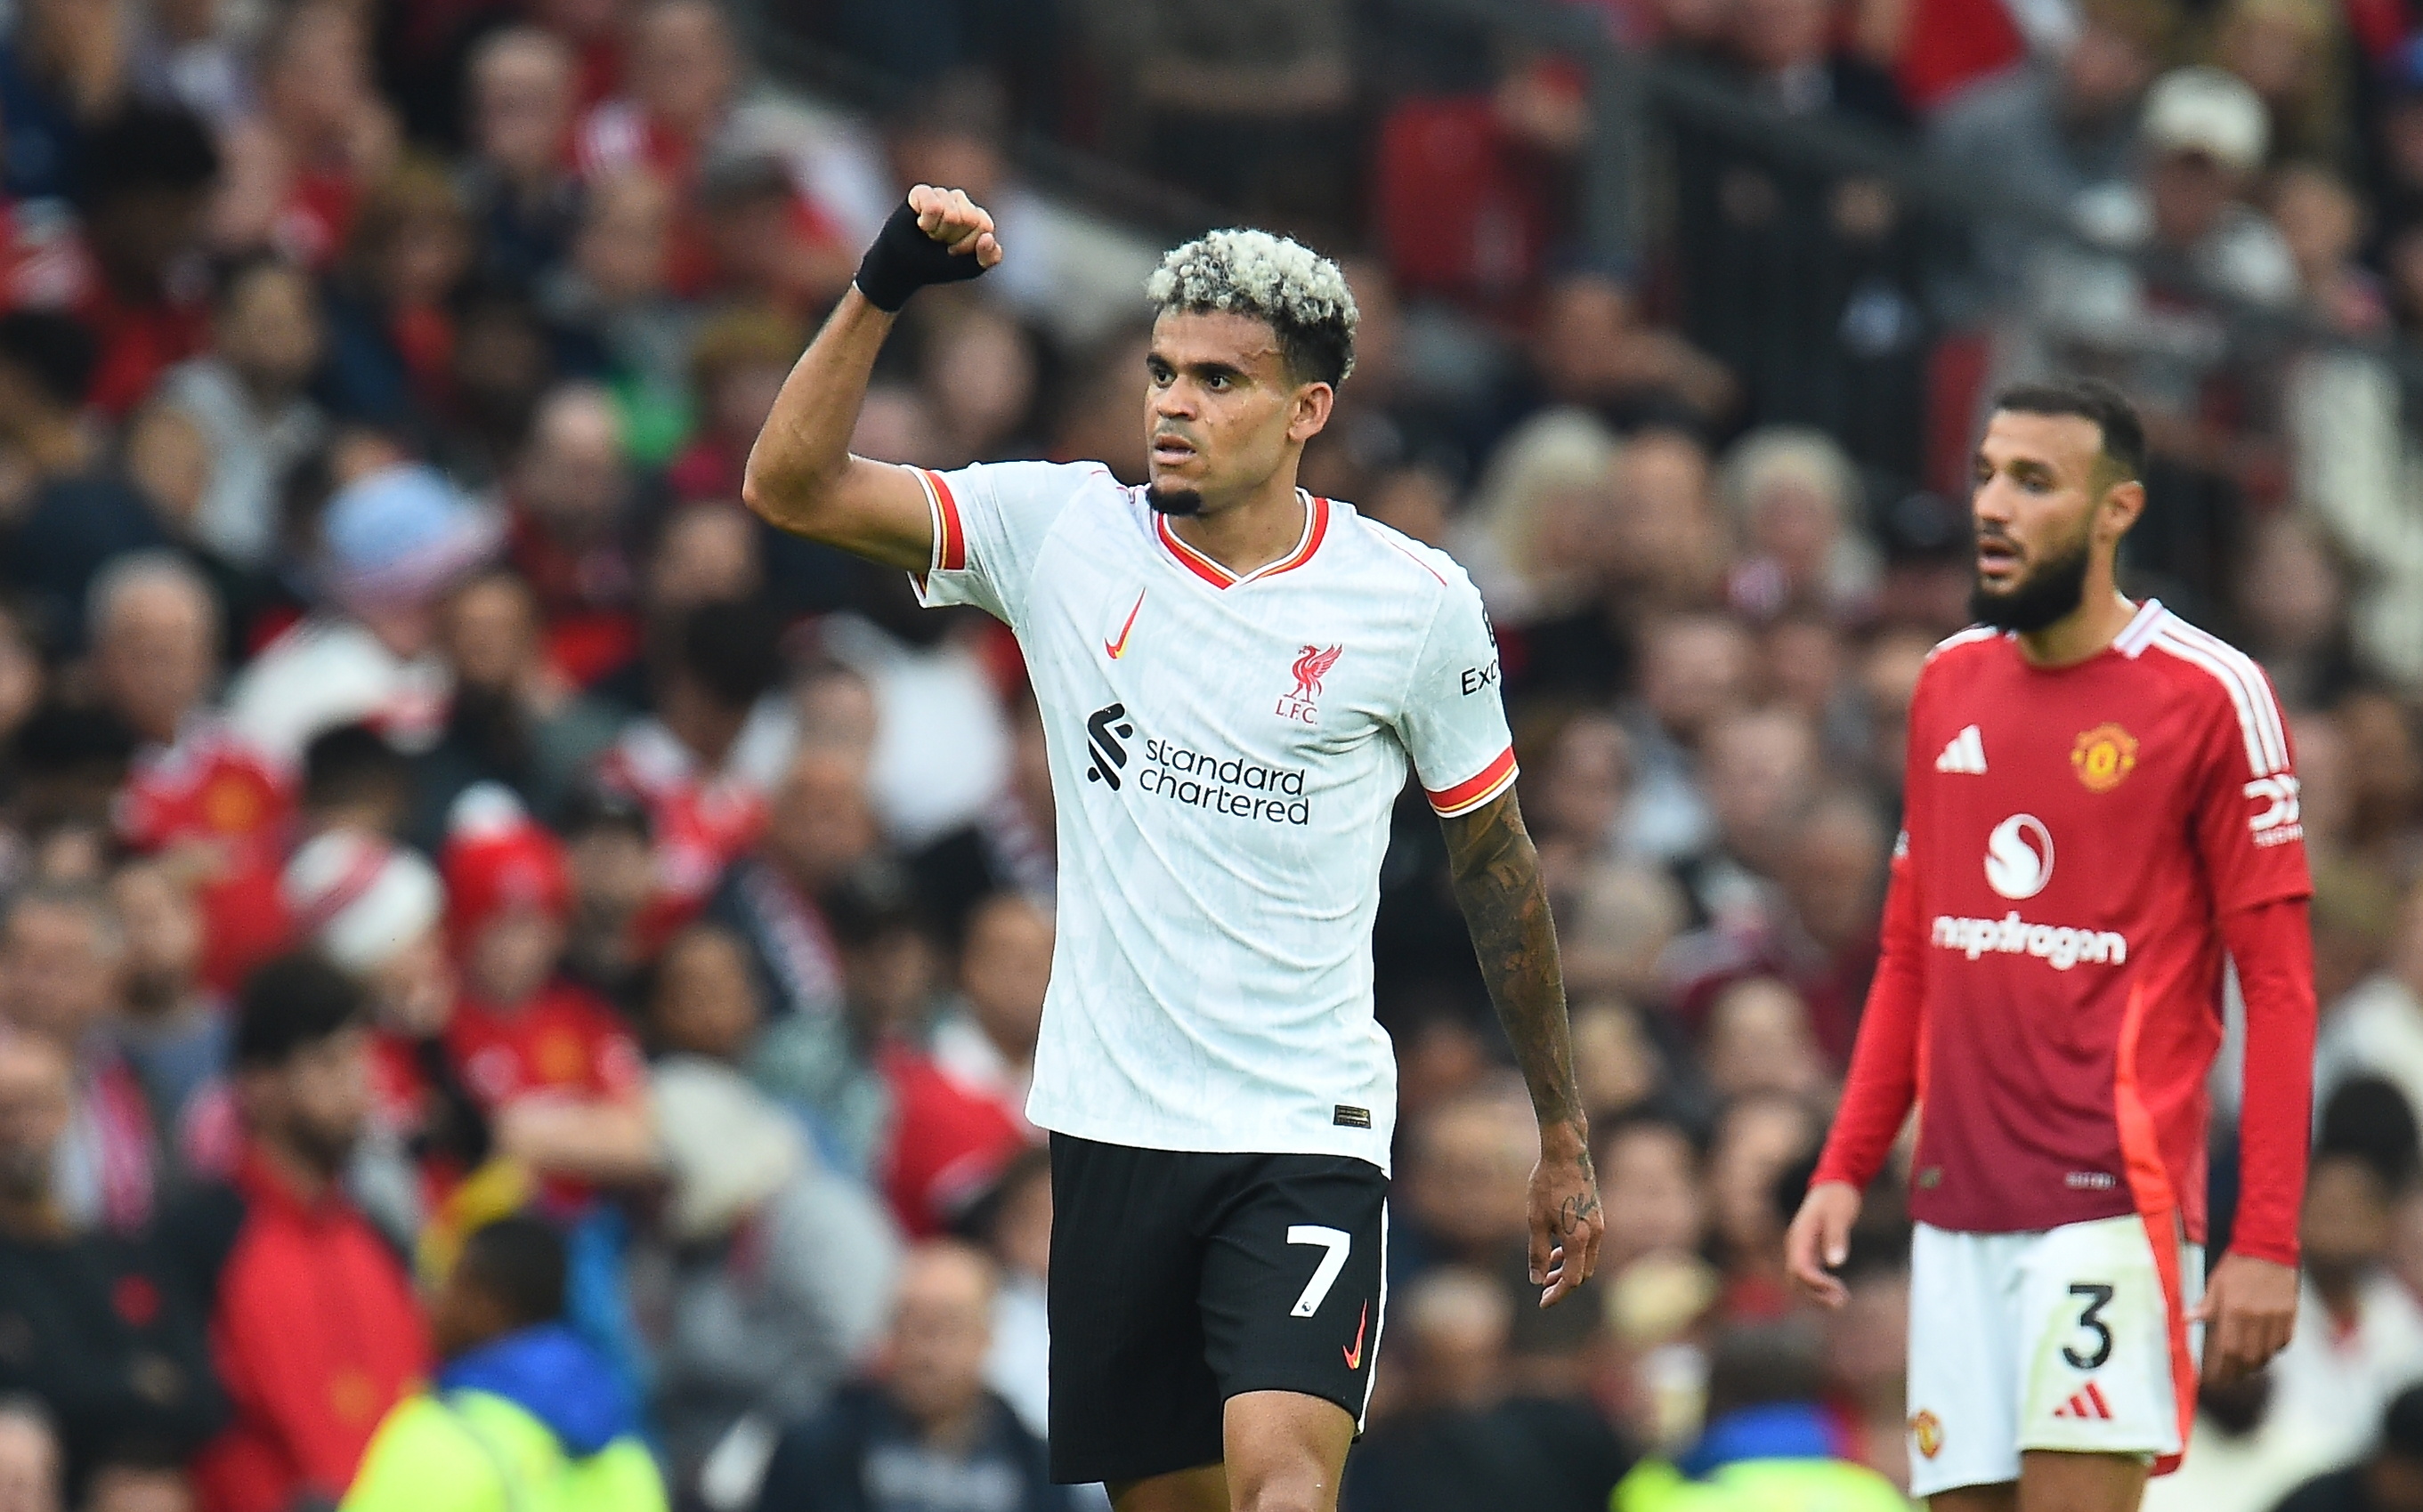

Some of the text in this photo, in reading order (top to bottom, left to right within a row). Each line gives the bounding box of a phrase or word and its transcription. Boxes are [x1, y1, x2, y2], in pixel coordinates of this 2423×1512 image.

[1139, 768, 1309, 825] chartered
[1146, 740, 1305, 796] standard
[1286, 1225, 1351, 1318] 7
[2062, 1284, 2113, 1369] 3
